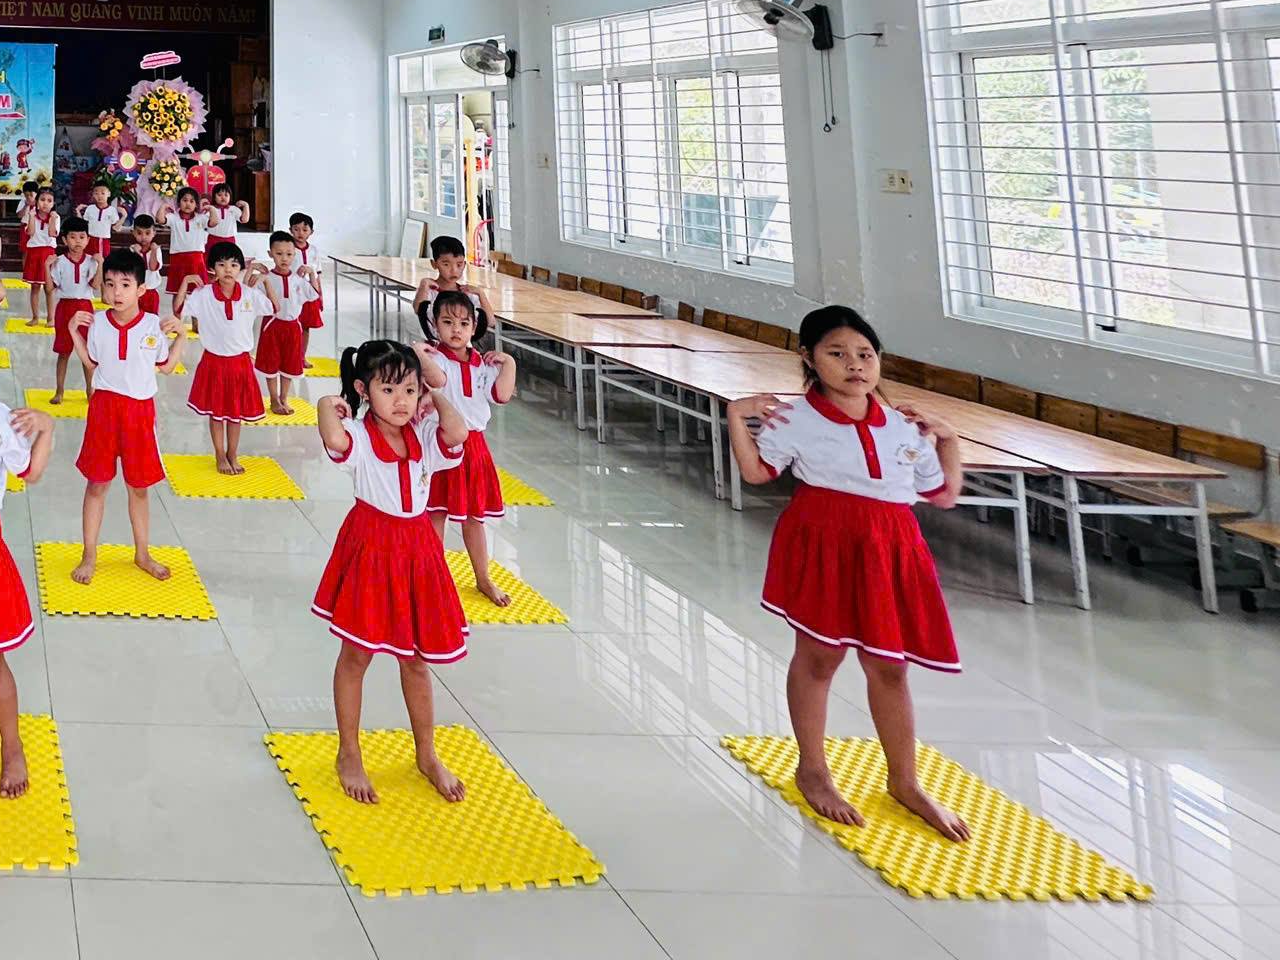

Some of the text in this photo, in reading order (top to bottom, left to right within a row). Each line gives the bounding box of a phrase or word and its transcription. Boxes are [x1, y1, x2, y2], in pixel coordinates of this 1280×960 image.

[32, 2, 65, 18] NAM
[70, 2, 122, 23] QUANG
[127, 5, 165, 22] VINH
[169, 2, 213, 24] MUÔN
